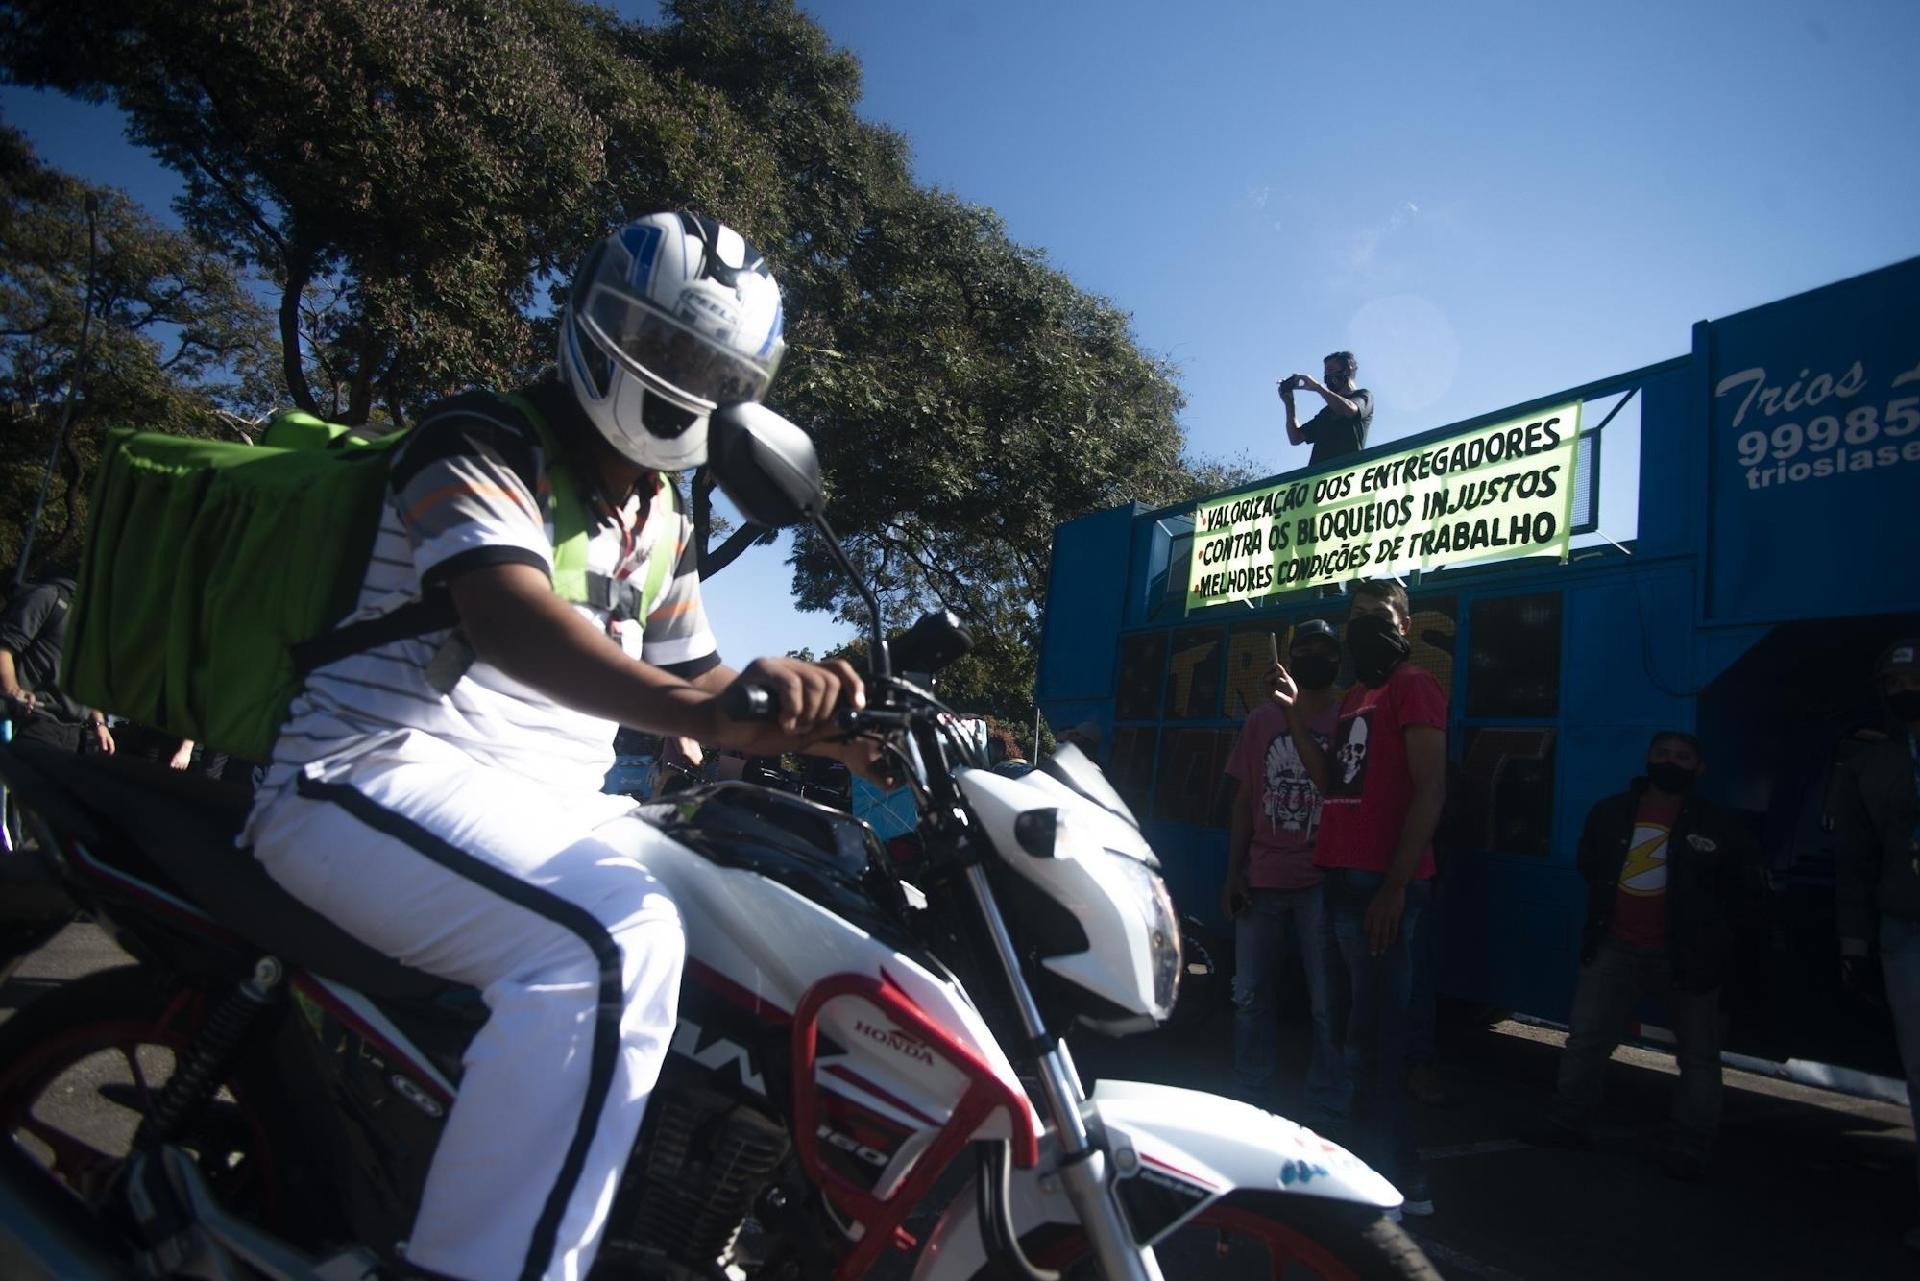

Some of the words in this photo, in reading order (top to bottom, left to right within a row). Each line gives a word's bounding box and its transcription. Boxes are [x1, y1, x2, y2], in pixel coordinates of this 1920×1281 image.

[1714, 360, 1868, 428] Trios
[1737, 396, 1920, 467] 99985
[1207, 482, 1307, 532] VALORIZAÇÃO
[1314, 472, 1355, 501] DOS
[1361, 417, 1561, 493] ENTREGADORES
[1203, 530, 1262, 566] CONTRA
[1268, 521, 1289, 550] OS
[1297, 496, 1412, 546] BLOQUEIOS
[1422, 464, 1560, 520] INJUSTOS
[1200, 566, 1272, 599] MELHORES
[1277, 542, 1370, 586] CONDIÇÕES
[1375, 538, 1399, 565] DE
[1409, 511, 1556, 559] TRABALHO
[855, 1019, 935, 1067] HONDA
